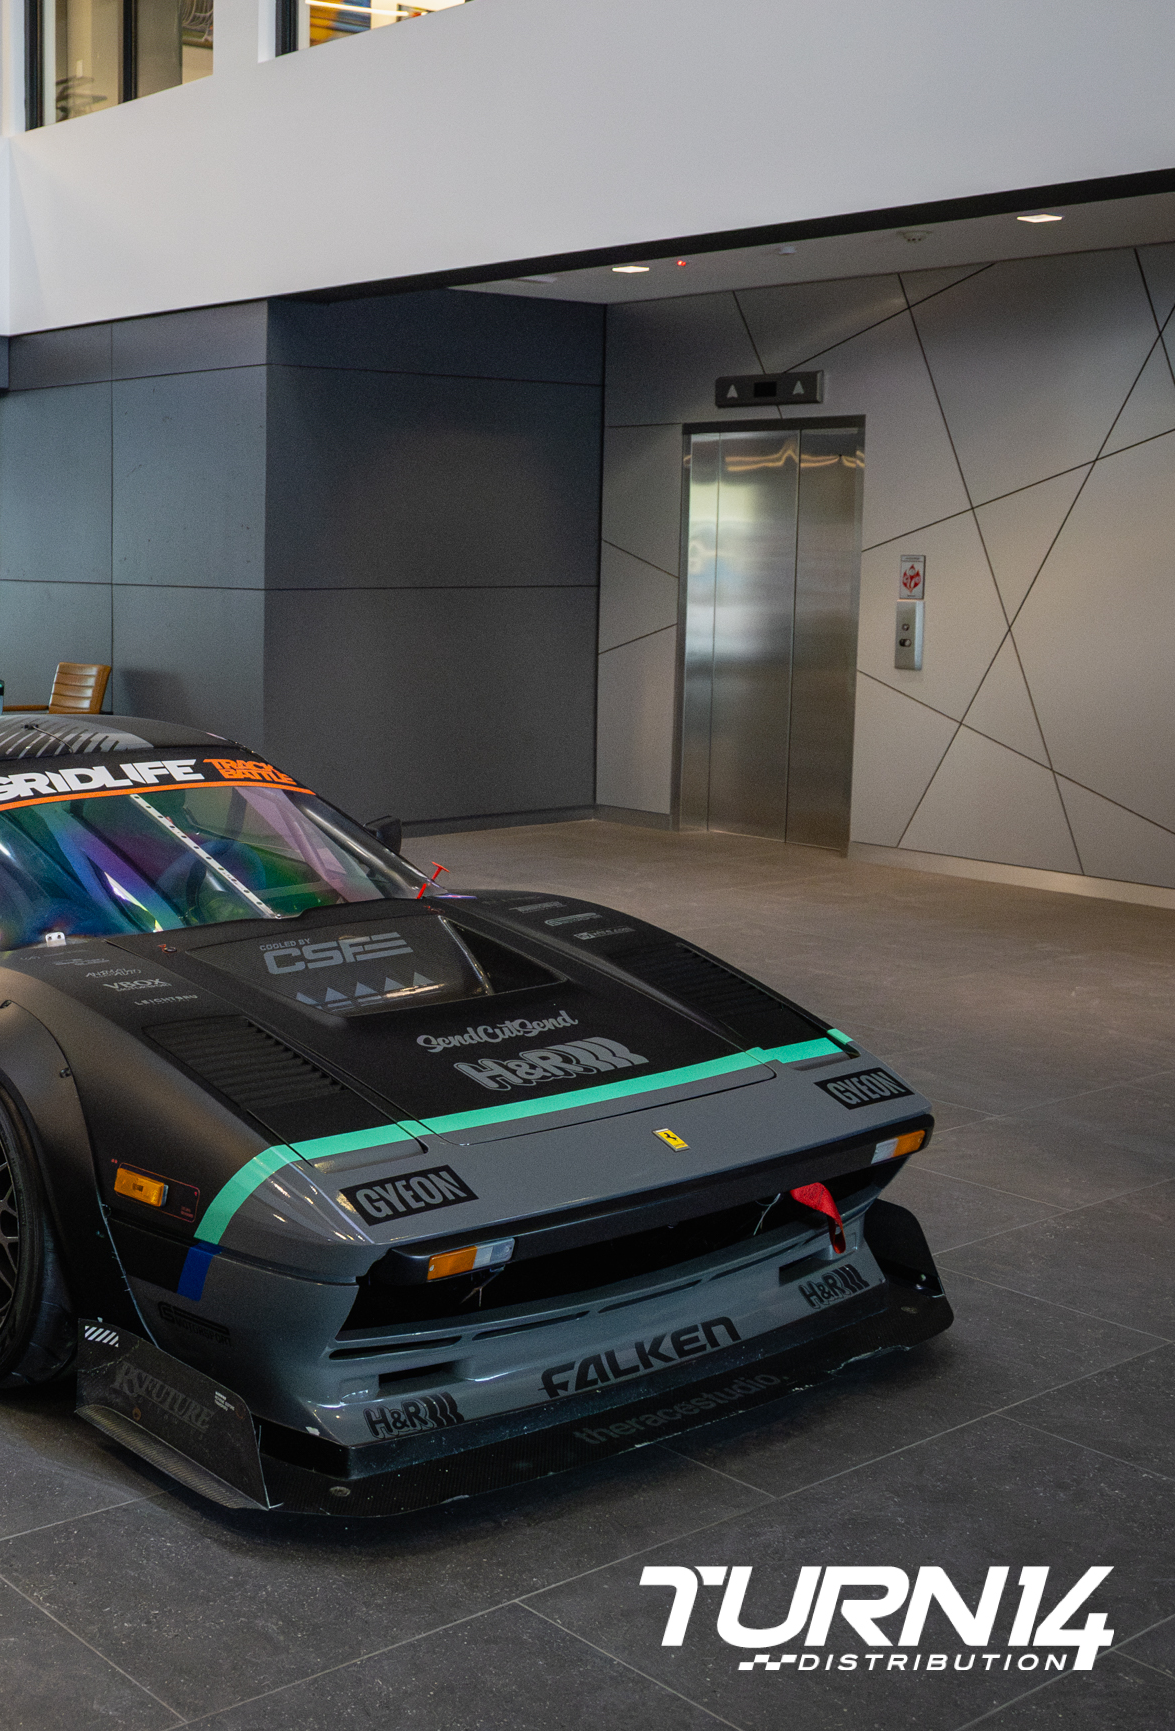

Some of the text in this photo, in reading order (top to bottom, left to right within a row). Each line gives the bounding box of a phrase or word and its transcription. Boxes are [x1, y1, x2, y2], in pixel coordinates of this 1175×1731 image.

[202, 758, 274, 772] TRACK
[219, 768, 298, 786] BATTLE
[258, 937, 312, 951] COOLED BY
[102, 978, 167, 990] VBOX
[416, 1010, 578, 1053] SendCutSend
[826, 1071, 907, 1105] GYEON
[355, 1171, 468, 1219] GYEON
[798, 1271, 853, 1310] H&R
[538, 1315, 742, 1399] FALKEN
[362, 1398, 435, 1440] H&R
